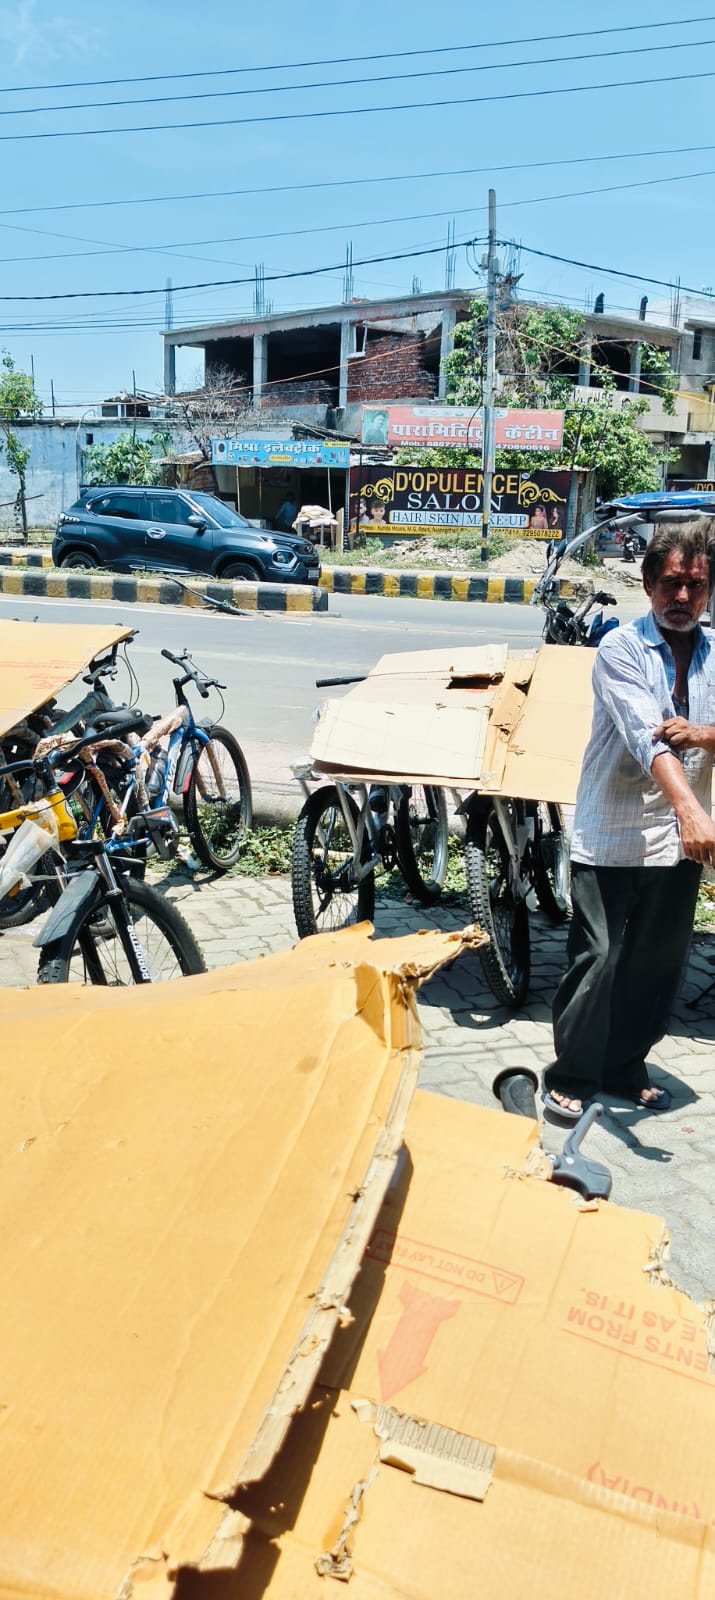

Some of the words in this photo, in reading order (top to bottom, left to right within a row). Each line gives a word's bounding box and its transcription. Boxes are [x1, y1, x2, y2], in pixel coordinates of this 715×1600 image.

[396, 472, 518, 494] D'OPULENCE
[408, 493, 504, 511] SALON
[392, 511, 421, 523] HAIR
[429, 513, 459, 525] SKIN
[408, 1250, 435, 1265] LAY
[436, 1259, 465, 1276] NOT
[466, 1269, 486, 1283] DO
[580, 1287, 608, 1311] IS.
[613, 1301, 636, 1321] IT
[567, 1306, 638, 1346] FROM
[641, 1311, 676, 1333] AS
